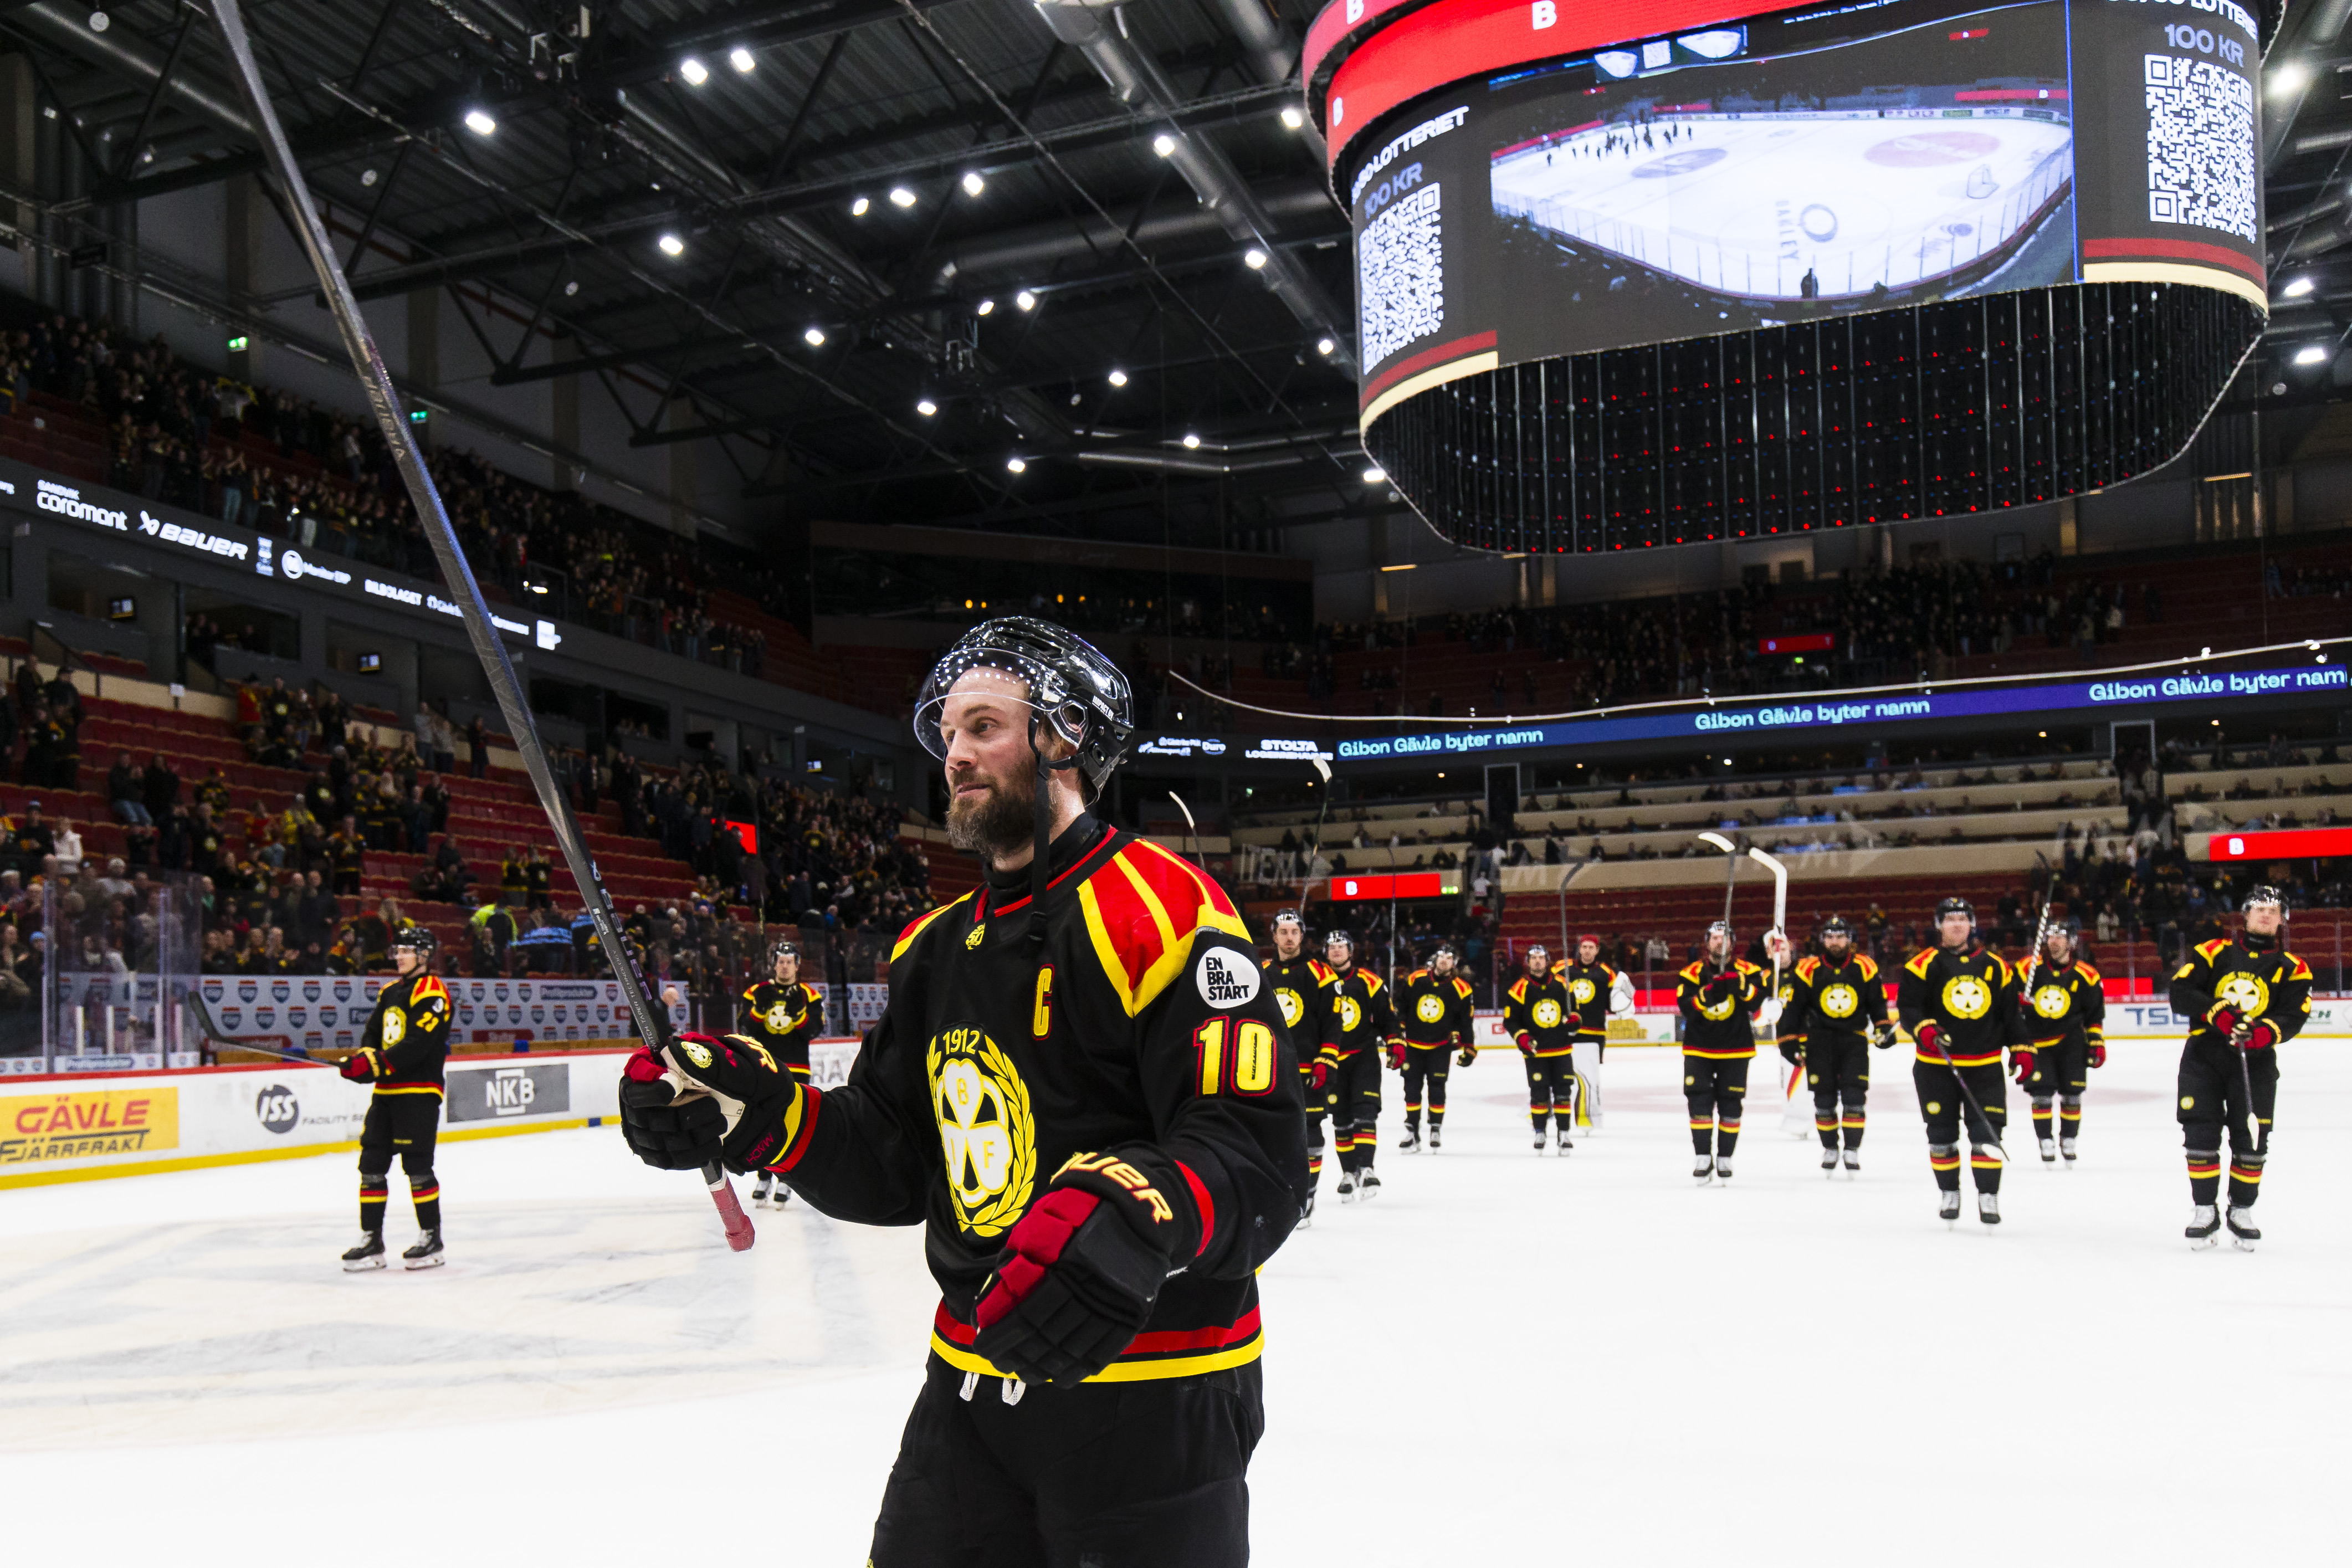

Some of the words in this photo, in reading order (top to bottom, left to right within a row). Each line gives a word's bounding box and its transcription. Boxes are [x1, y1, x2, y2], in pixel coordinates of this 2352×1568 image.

[1533, 0, 1557, 29] B
[2164, 23, 2215, 54] 100
[2218, 34, 2244, 68] KR
[1392, 162, 1422, 196] KR
[2089, 682, 2156, 702] Gibon
[2161, 675, 2224, 696] Gävle
[2230, 673, 2290, 694] byter
[2297, 669, 2348, 686] nam
[1695, 713, 1754, 730] Gibon
[1758, 706, 1813, 725] Gävle
[1817, 704, 1871, 724] byter
[1875, 700, 1930, 717] namn
[1260, 739, 1318, 752] STOLTA
[1339, 741, 1391, 757] Gibon
[1393, 735, 1442, 752] Gävle
[1445, 734, 1492, 751] byter
[1496, 730, 1544, 745] namn
[1206, 957, 1223, 970] EN
[1207, 971, 1234, 985] BRA
[1033, 966, 1053, 1038] C
[1208, 985, 1249, 1001] START
[942, 1028, 980, 1055] 1912
[1195, 1016, 1276, 1097] 10
[259, 1089, 298, 1123] ISS
[485, 1077, 535, 1108] NKB
[956, 1078, 969, 1105] B
[15, 1095, 151, 1134] GÄVLE
[982, 1140, 995, 1169] F
[1050, 1152, 1174, 1225] UER
